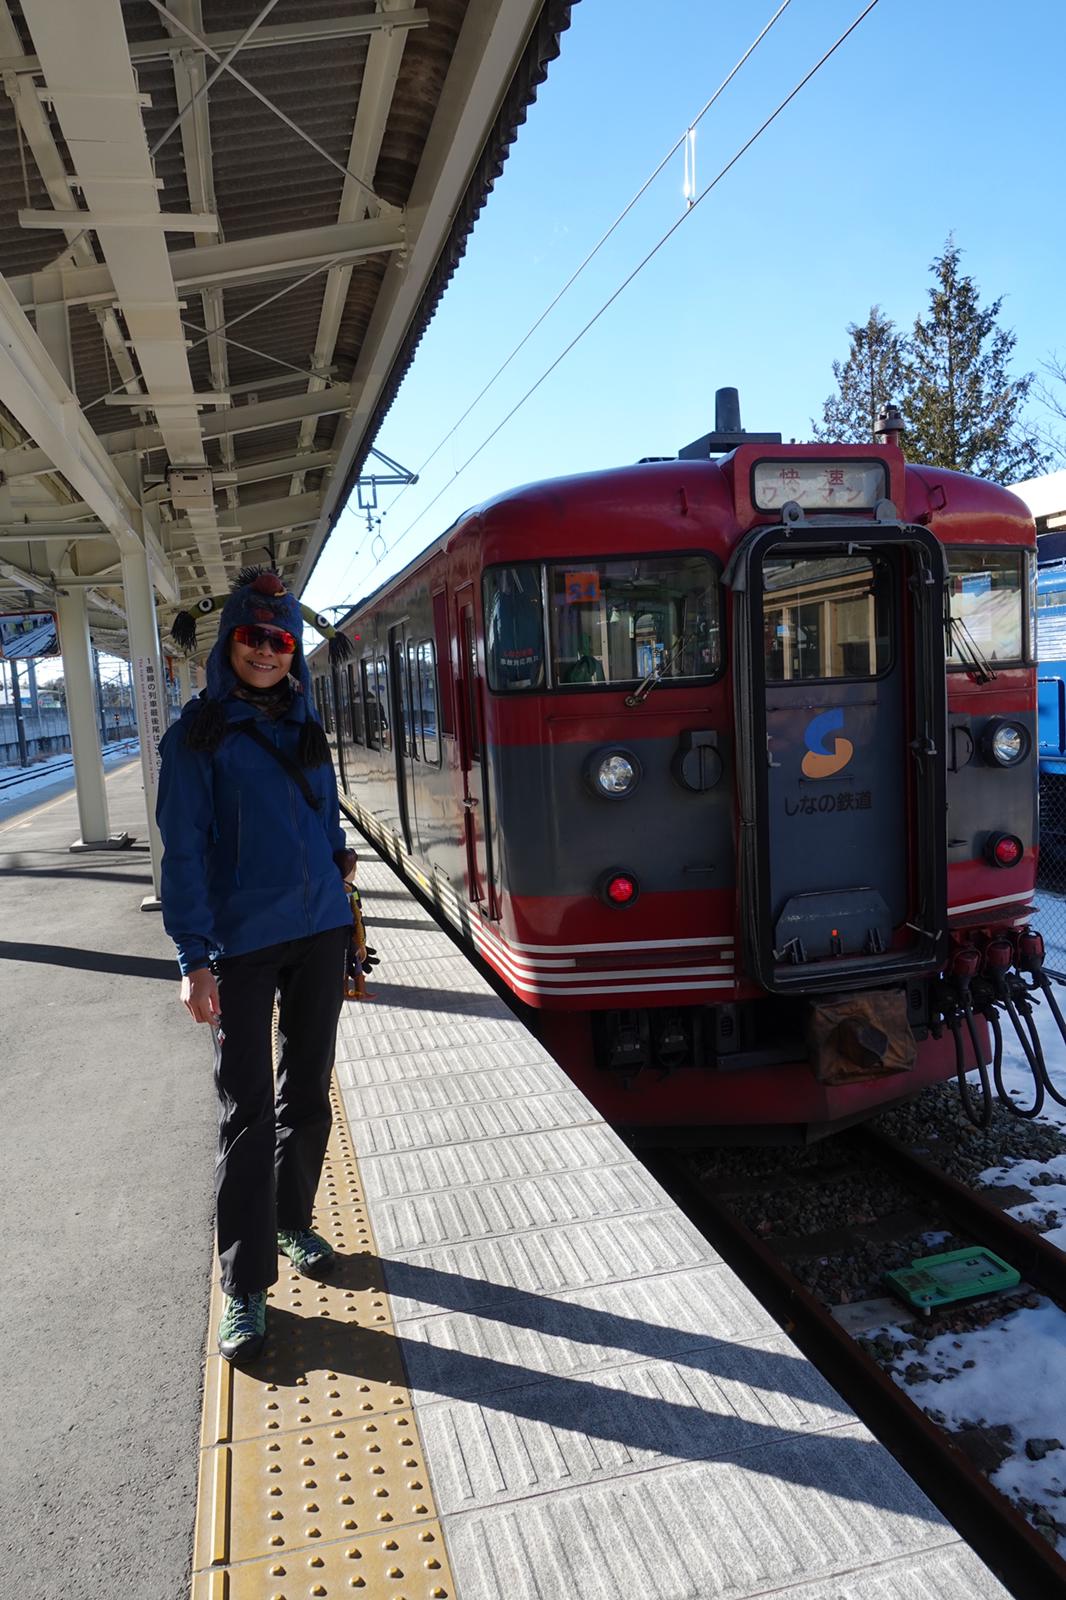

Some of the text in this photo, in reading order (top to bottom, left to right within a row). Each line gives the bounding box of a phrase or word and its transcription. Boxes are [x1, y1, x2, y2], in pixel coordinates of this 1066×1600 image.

[780, 468, 845, 486] 快速
[146, 657, 162, 772] 1番線の列車最後尾はこちら
[784, 790, 873, 817] しなの鉄道
